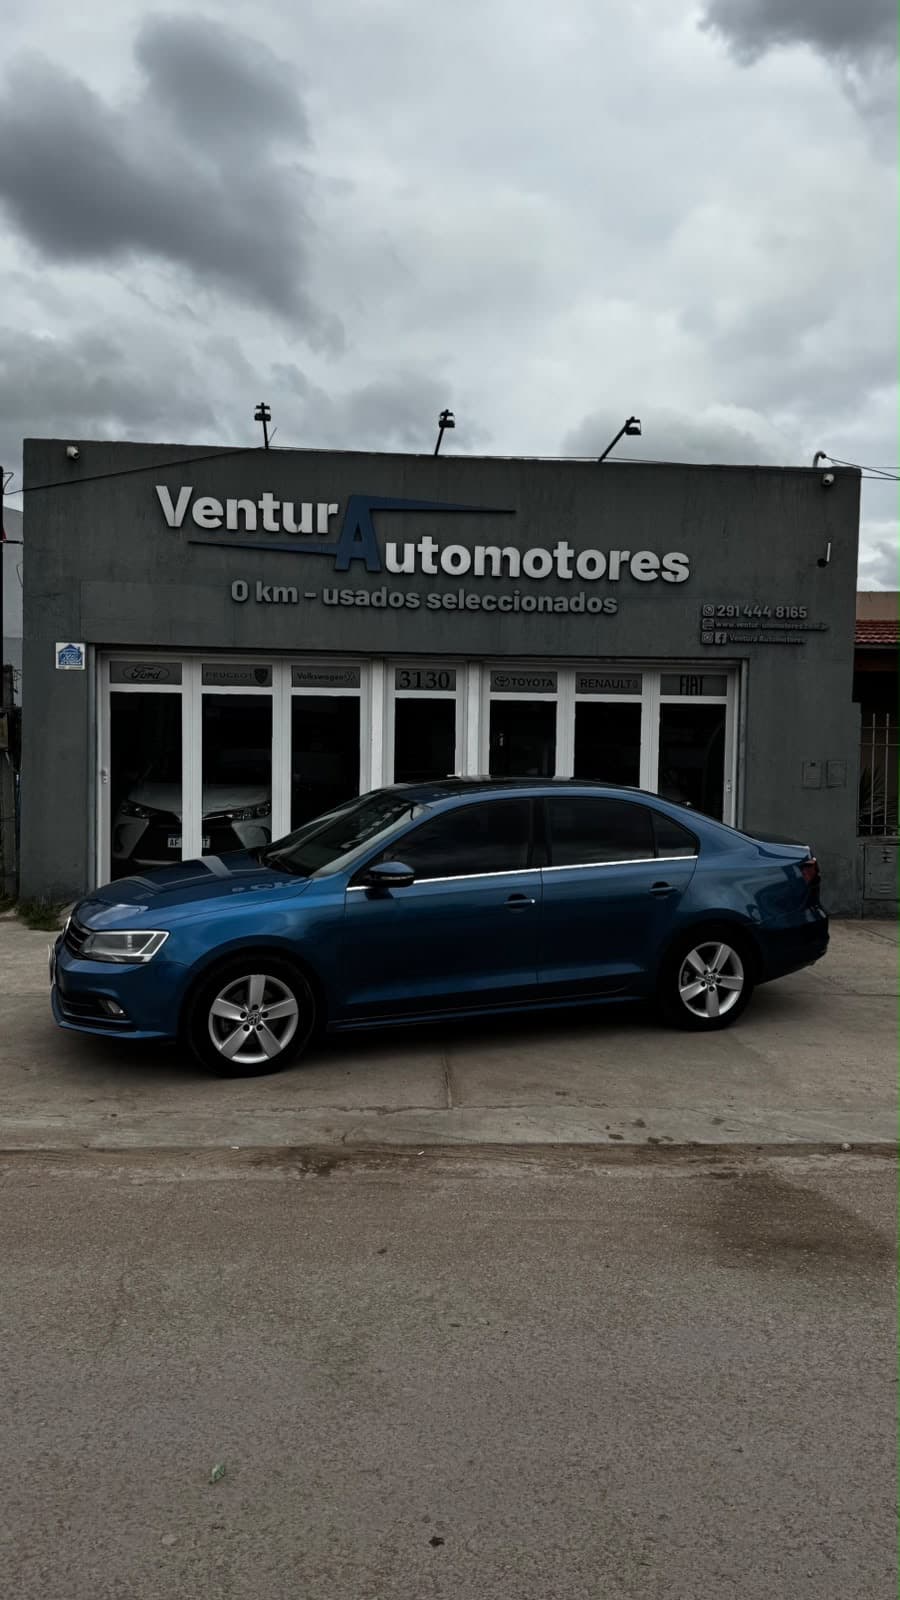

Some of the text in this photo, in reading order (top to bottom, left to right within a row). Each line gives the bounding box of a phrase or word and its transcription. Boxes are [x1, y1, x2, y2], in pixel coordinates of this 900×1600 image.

[231, 579, 249, 602] 0
[255, 580, 298, 603] km
[322, 586, 421, 609] usados
[426, 588, 618, 614] seleccionados
[717, 605, 808, 619] 291 444 8165
[131, 665, 161, 680] Ford
[296, 672, 344, 682] Volkswagen
[399, 670, 450, 690] 3130
[512, 677, 554, 687] TOYOTA
[579, 678, 633, 688] RENAULT
[680, 674, 704, 696] FIAT
